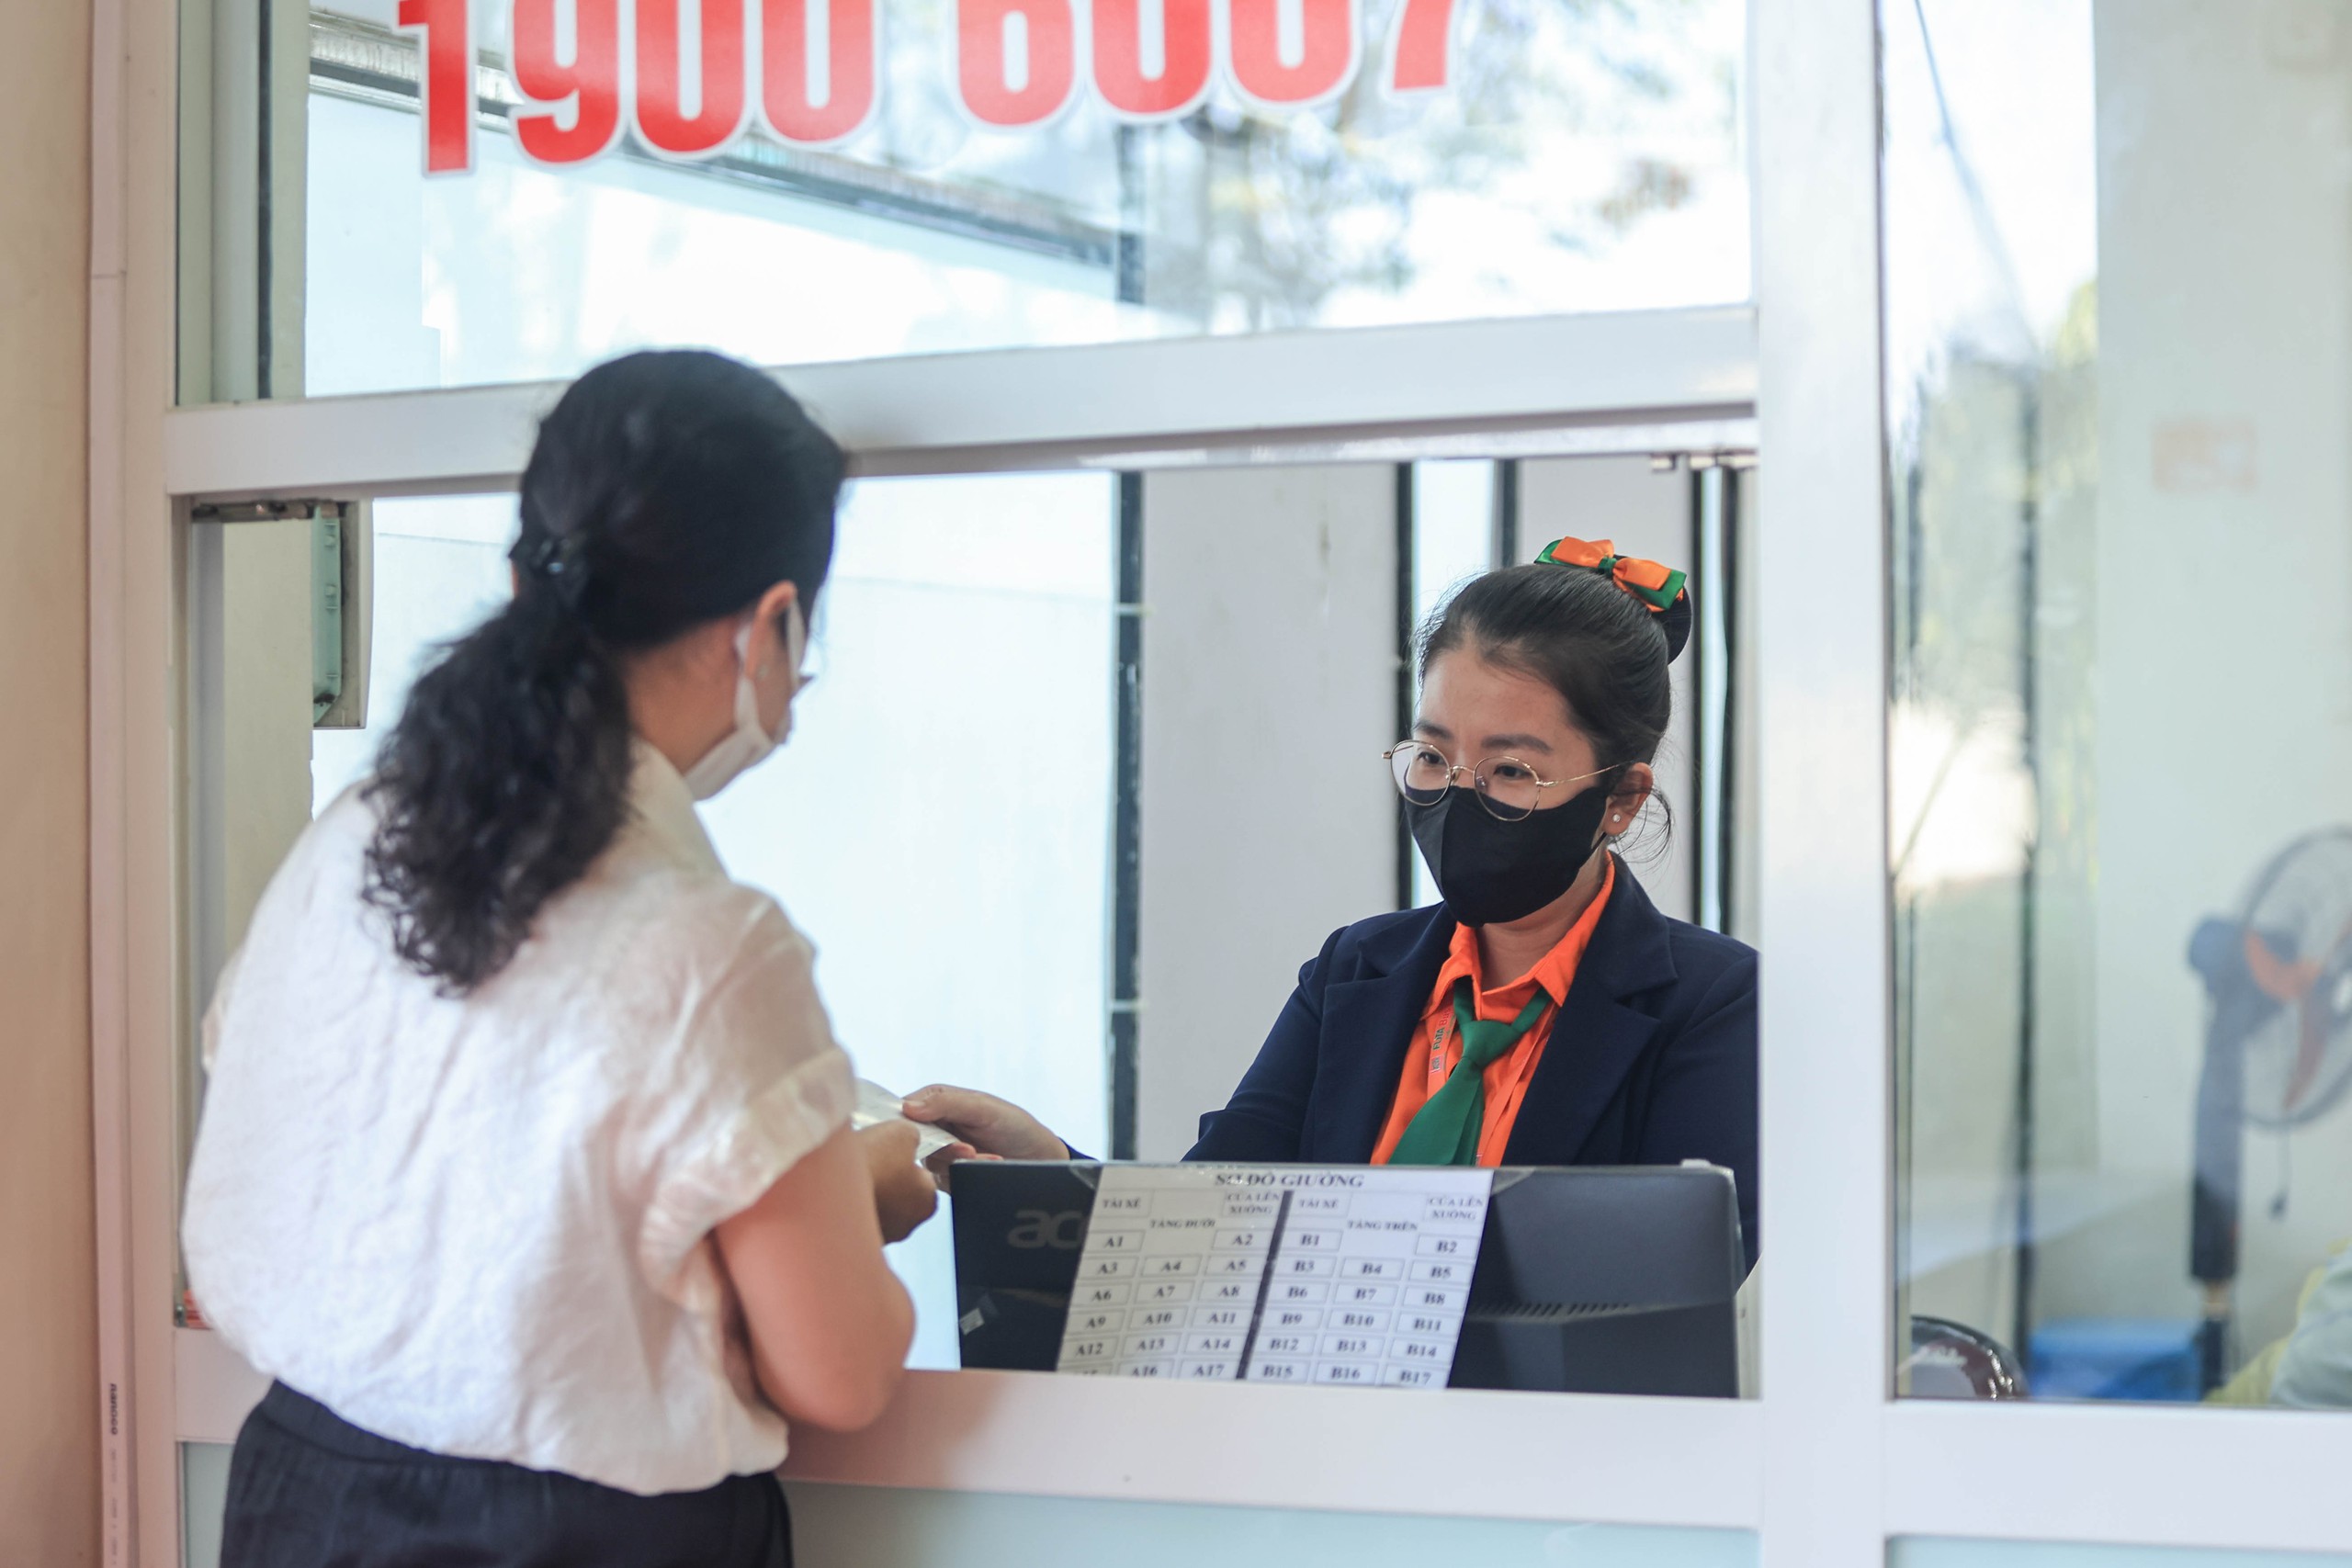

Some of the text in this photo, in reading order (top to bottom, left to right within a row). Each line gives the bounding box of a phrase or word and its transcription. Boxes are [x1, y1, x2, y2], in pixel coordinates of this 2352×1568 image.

[397, 0, 874, 173] 1900
[1009, 1210, 1088, 1249] ac
[1103, 1235, 1124, 1248] A1
[1231, 1234, 1253, 1246] A2
[1299, 1234, 1320, 1246] B1
[1436, 1241, 1458, 1253] B2
[1097, 1261, 1117, 1275] A3
[1159, 1259, 1182, 1273] A4
[1225, 1258, 1247, 1272] A5
[1294, 1260, 1316, 1272] B3
[1362, 1263, 1383, 1275] B4
[1430, 1267, 1453, 1279] B5
[1091, 1290, 1112, 1301] A6
[1154, 1286, 1175, 1298] A7
[1219, 1285, 1241, 1297] A8
[1287, 1287, 1308, 1299] B6
[1354, 1288, 1376, 1300] B7
[1424, 1292, 1446, 1305] B8
[1086, 1317, 1106, 1328] A9
[1144, 1313, 1171, 1325] A10
[1208, 1313, 1237, 1324] A11
[1281, 1314, 1303, 1325] B9
[1343, 1314, 1374, 1326] B10
[1413, 1318, 1442, 1331] B11
[1075, 1342, 1103, 1357] A12
[1137, 1338, 1165, 1351] A13
[1201, 1338, 1231, 1350] A14
[1270, 1338, 1299, 1351] B12
[1336, 1340, 1367, 1352] B13
[1407, 1344, 1438, 1358] B14
[1131, 1364, 1158, 1377] A16
[1194, 1364, 1226, 1377] A17
[1262, 1365, 1294, 1378] B15
[1332, 1367, 1361, 1380] B16
[1399, 1370, 1431, 1384] B17
